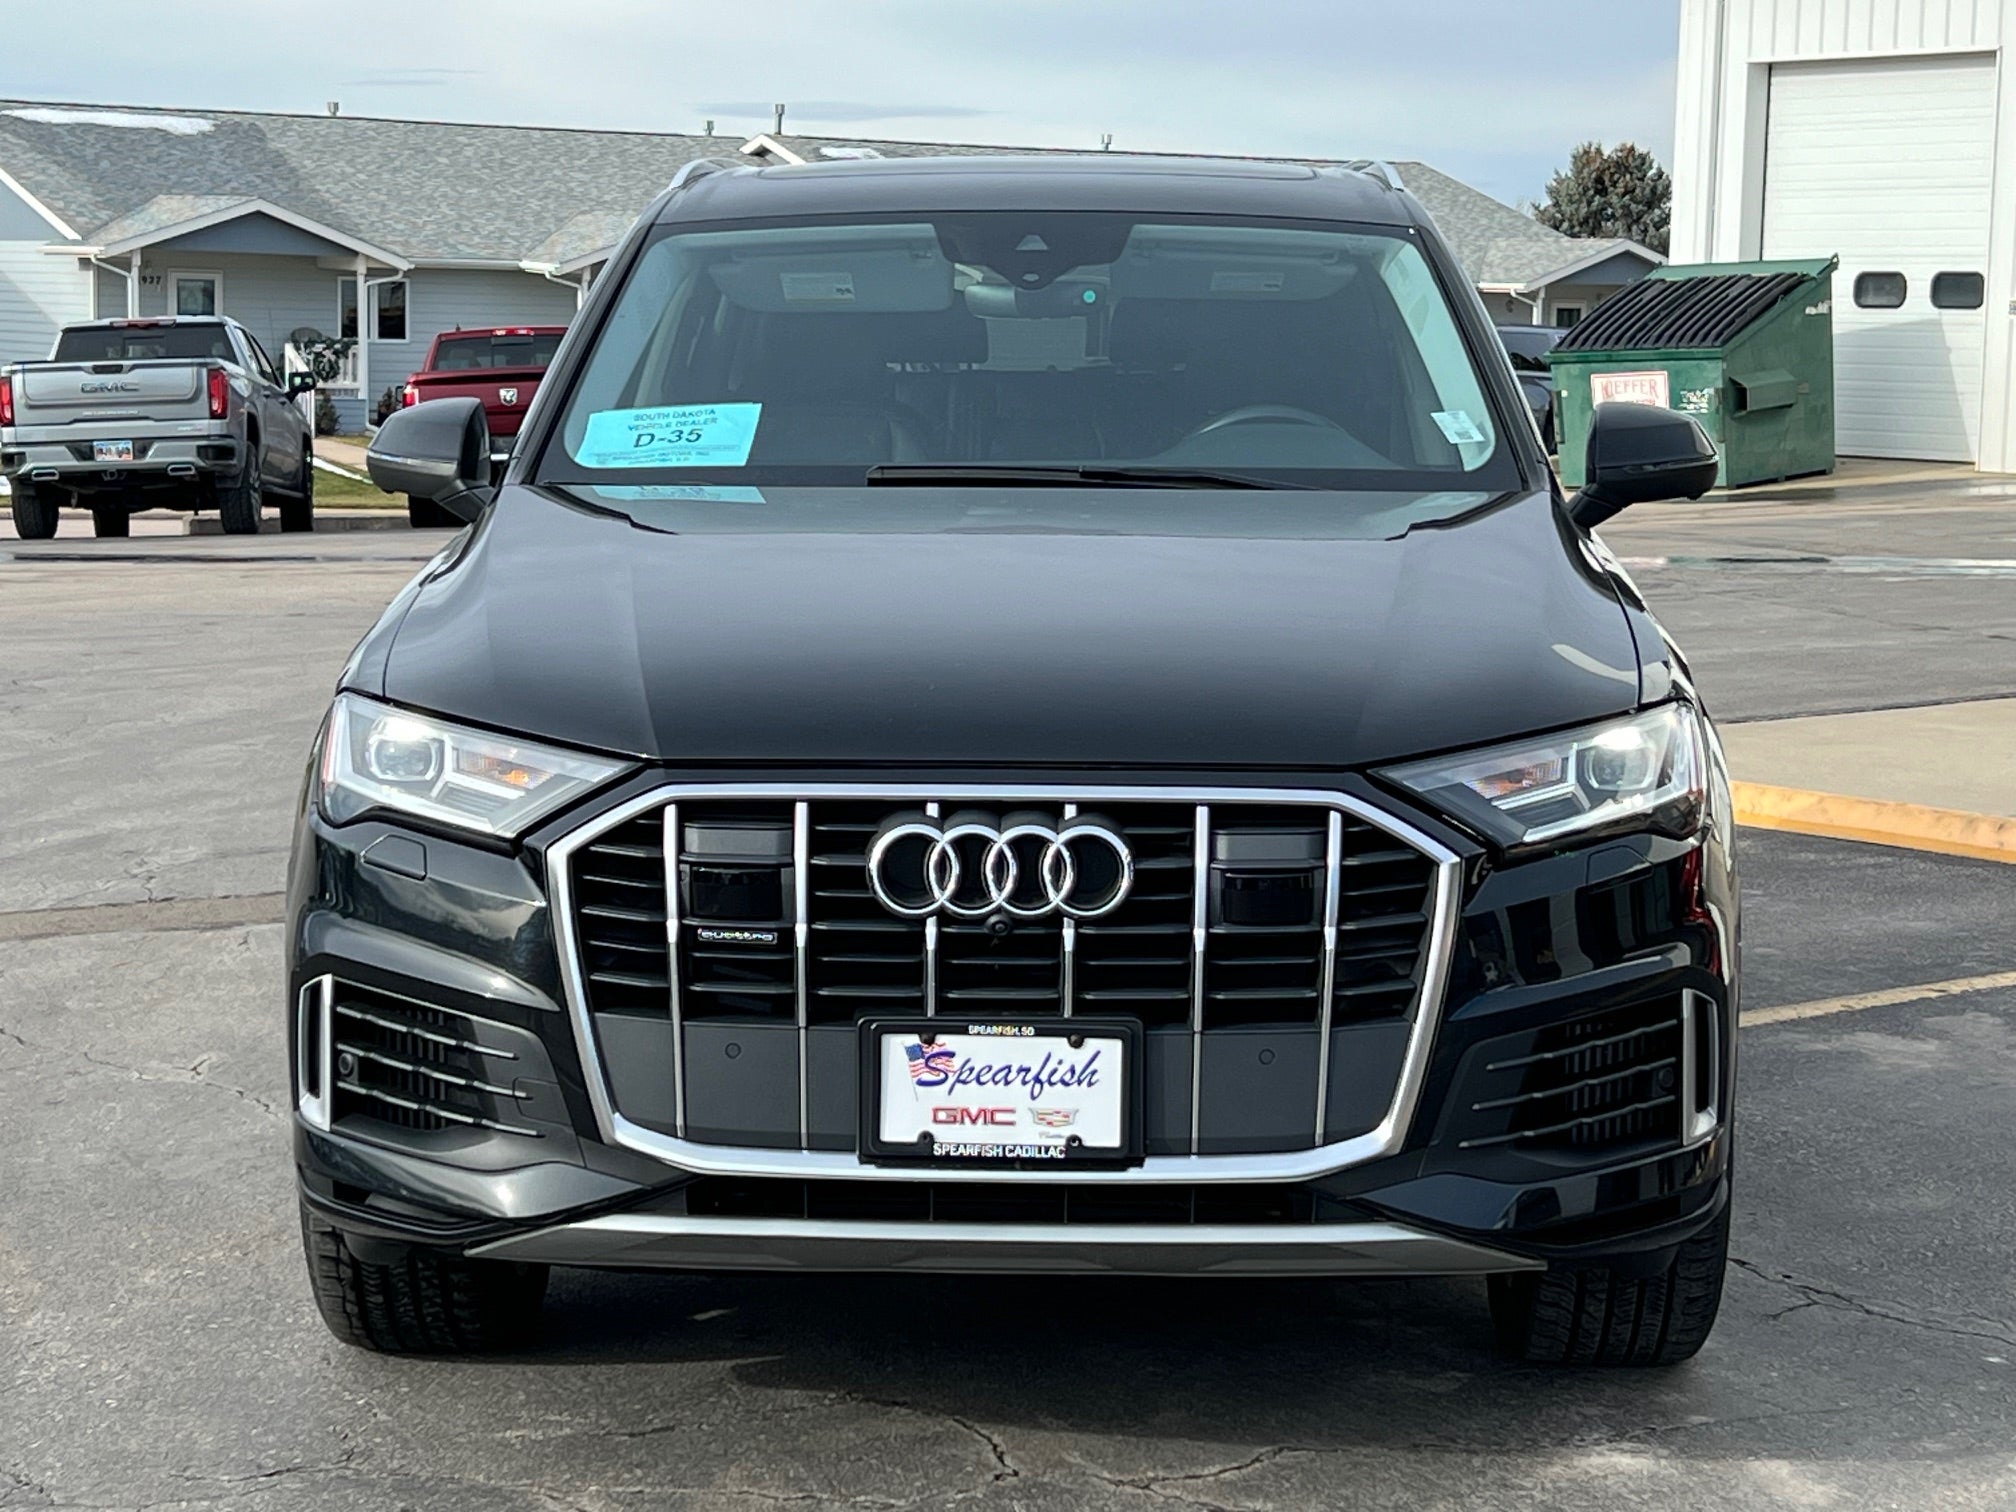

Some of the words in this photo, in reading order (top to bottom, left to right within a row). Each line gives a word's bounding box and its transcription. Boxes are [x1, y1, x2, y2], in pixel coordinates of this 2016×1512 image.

[81, 382, 139, 393] GMC
[634, 412, 670, 422] SOUTH
[672, 408, 717, 419] DAKOTA
[675, 417, 718, 428] DEALER
[633, 428, 703, 448] D-35
[916, 1050, 1101, 1101] Spearfish
[932, 1106, 1016, 1126] GMC
[933, 1142, 1003, 1156] SPEARFISH
[1005, 1143, 1066, 1158] CADILLAC
